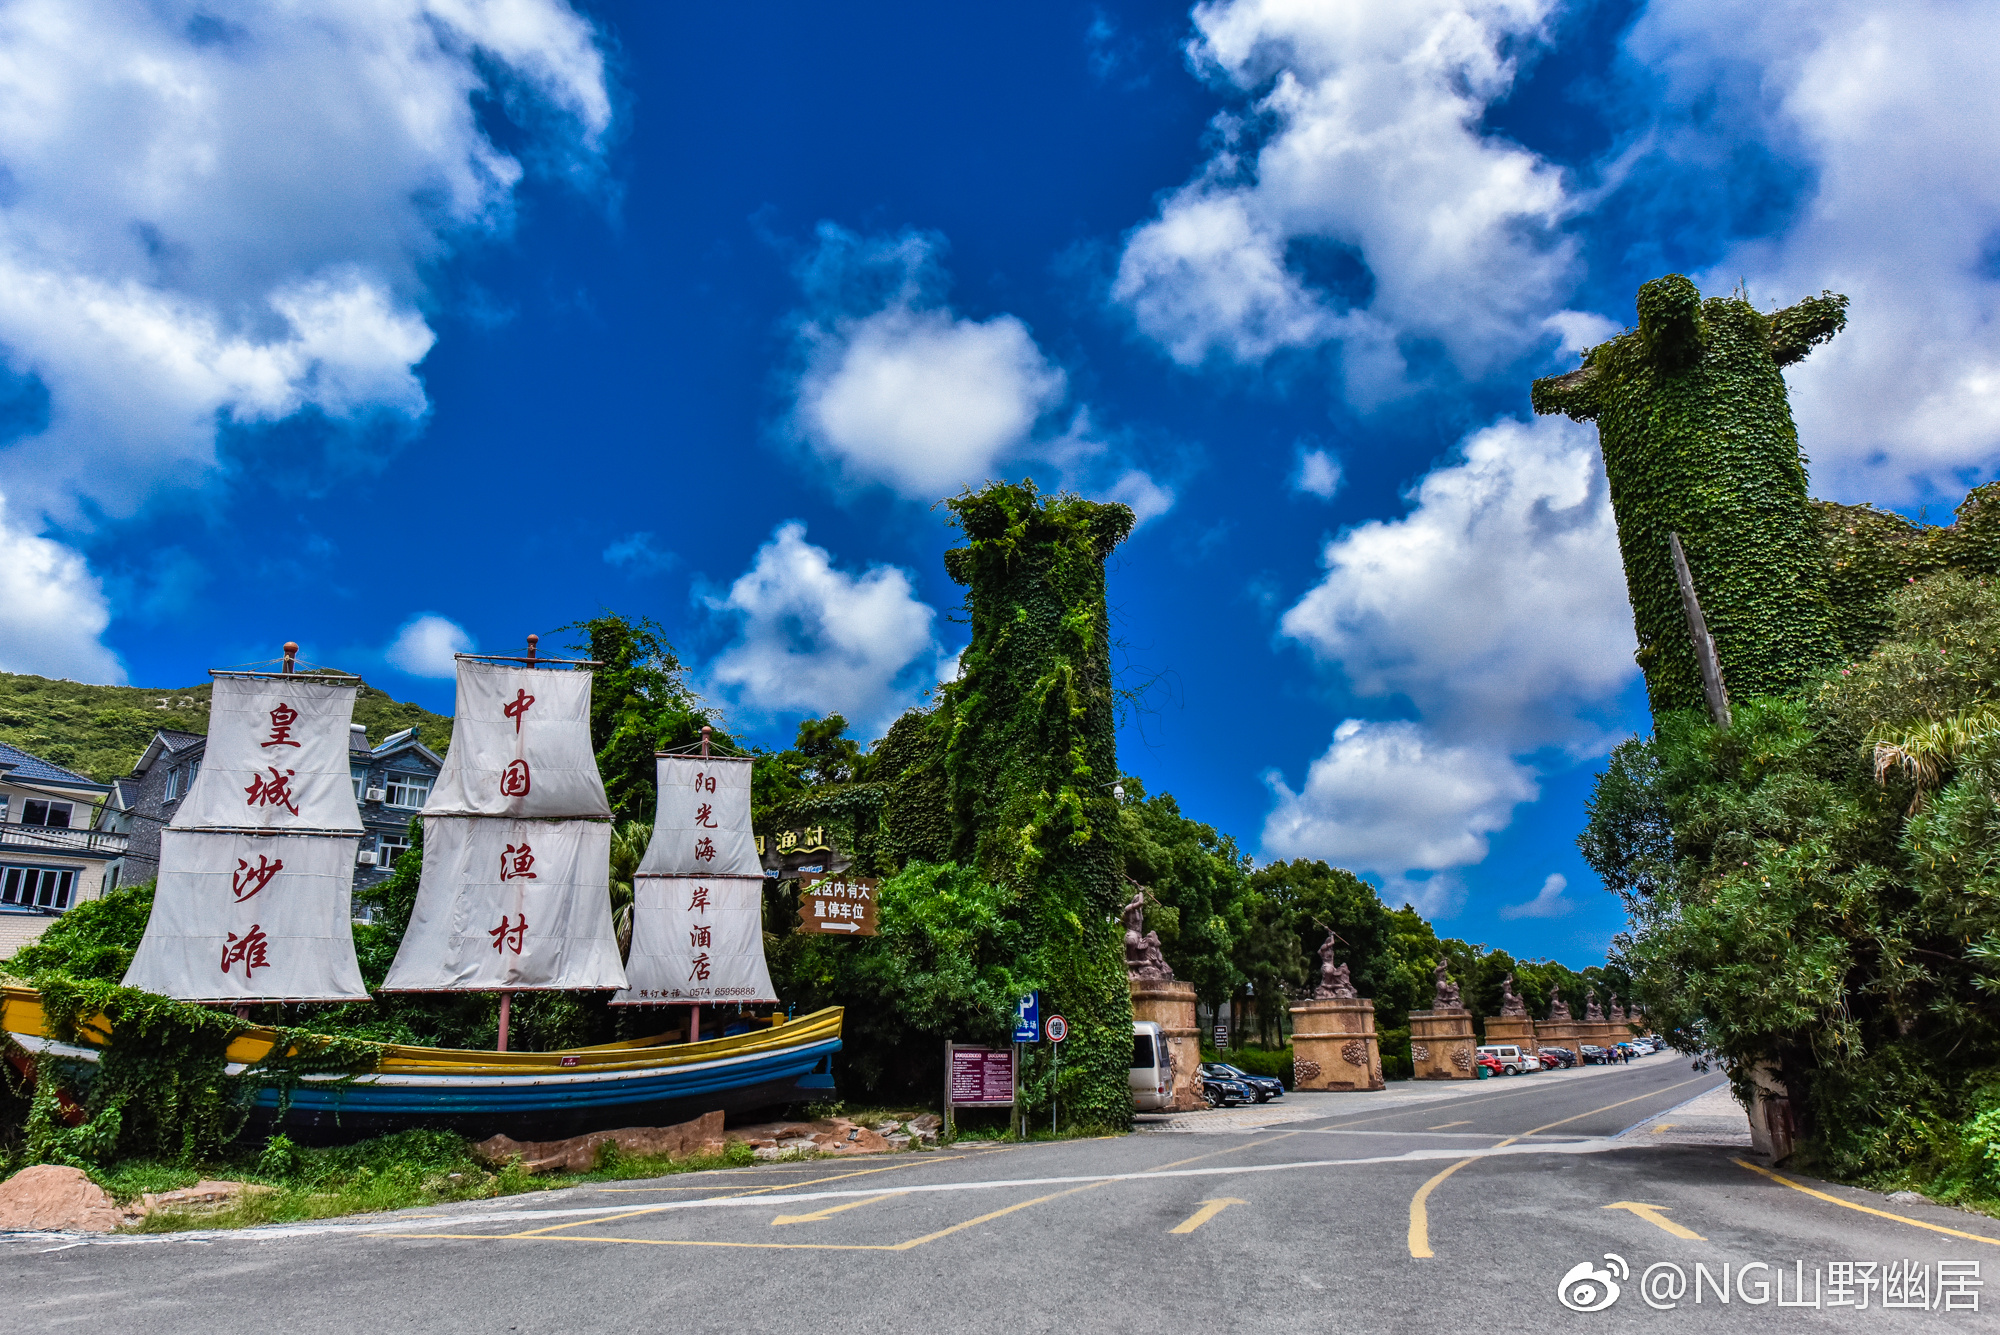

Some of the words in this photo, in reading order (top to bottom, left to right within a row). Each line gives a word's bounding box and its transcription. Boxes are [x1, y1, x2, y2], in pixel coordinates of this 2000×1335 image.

[488, 688, 537, 955] 中国渔村
[220, 702, 301, 979] 皇城沙滩
[687, 772, 718, 982] 阳光海岸酒店
[810, 879, 870, 900] 景区内有大
[814, 900, 865, 919] 量停车位
[689, 987, 711, 997] 0574
[714, 987, 756, 996] 65956888
[1020, 992, 1034, 1018] P
[1050, 1020, 1063, 1036] 慢
